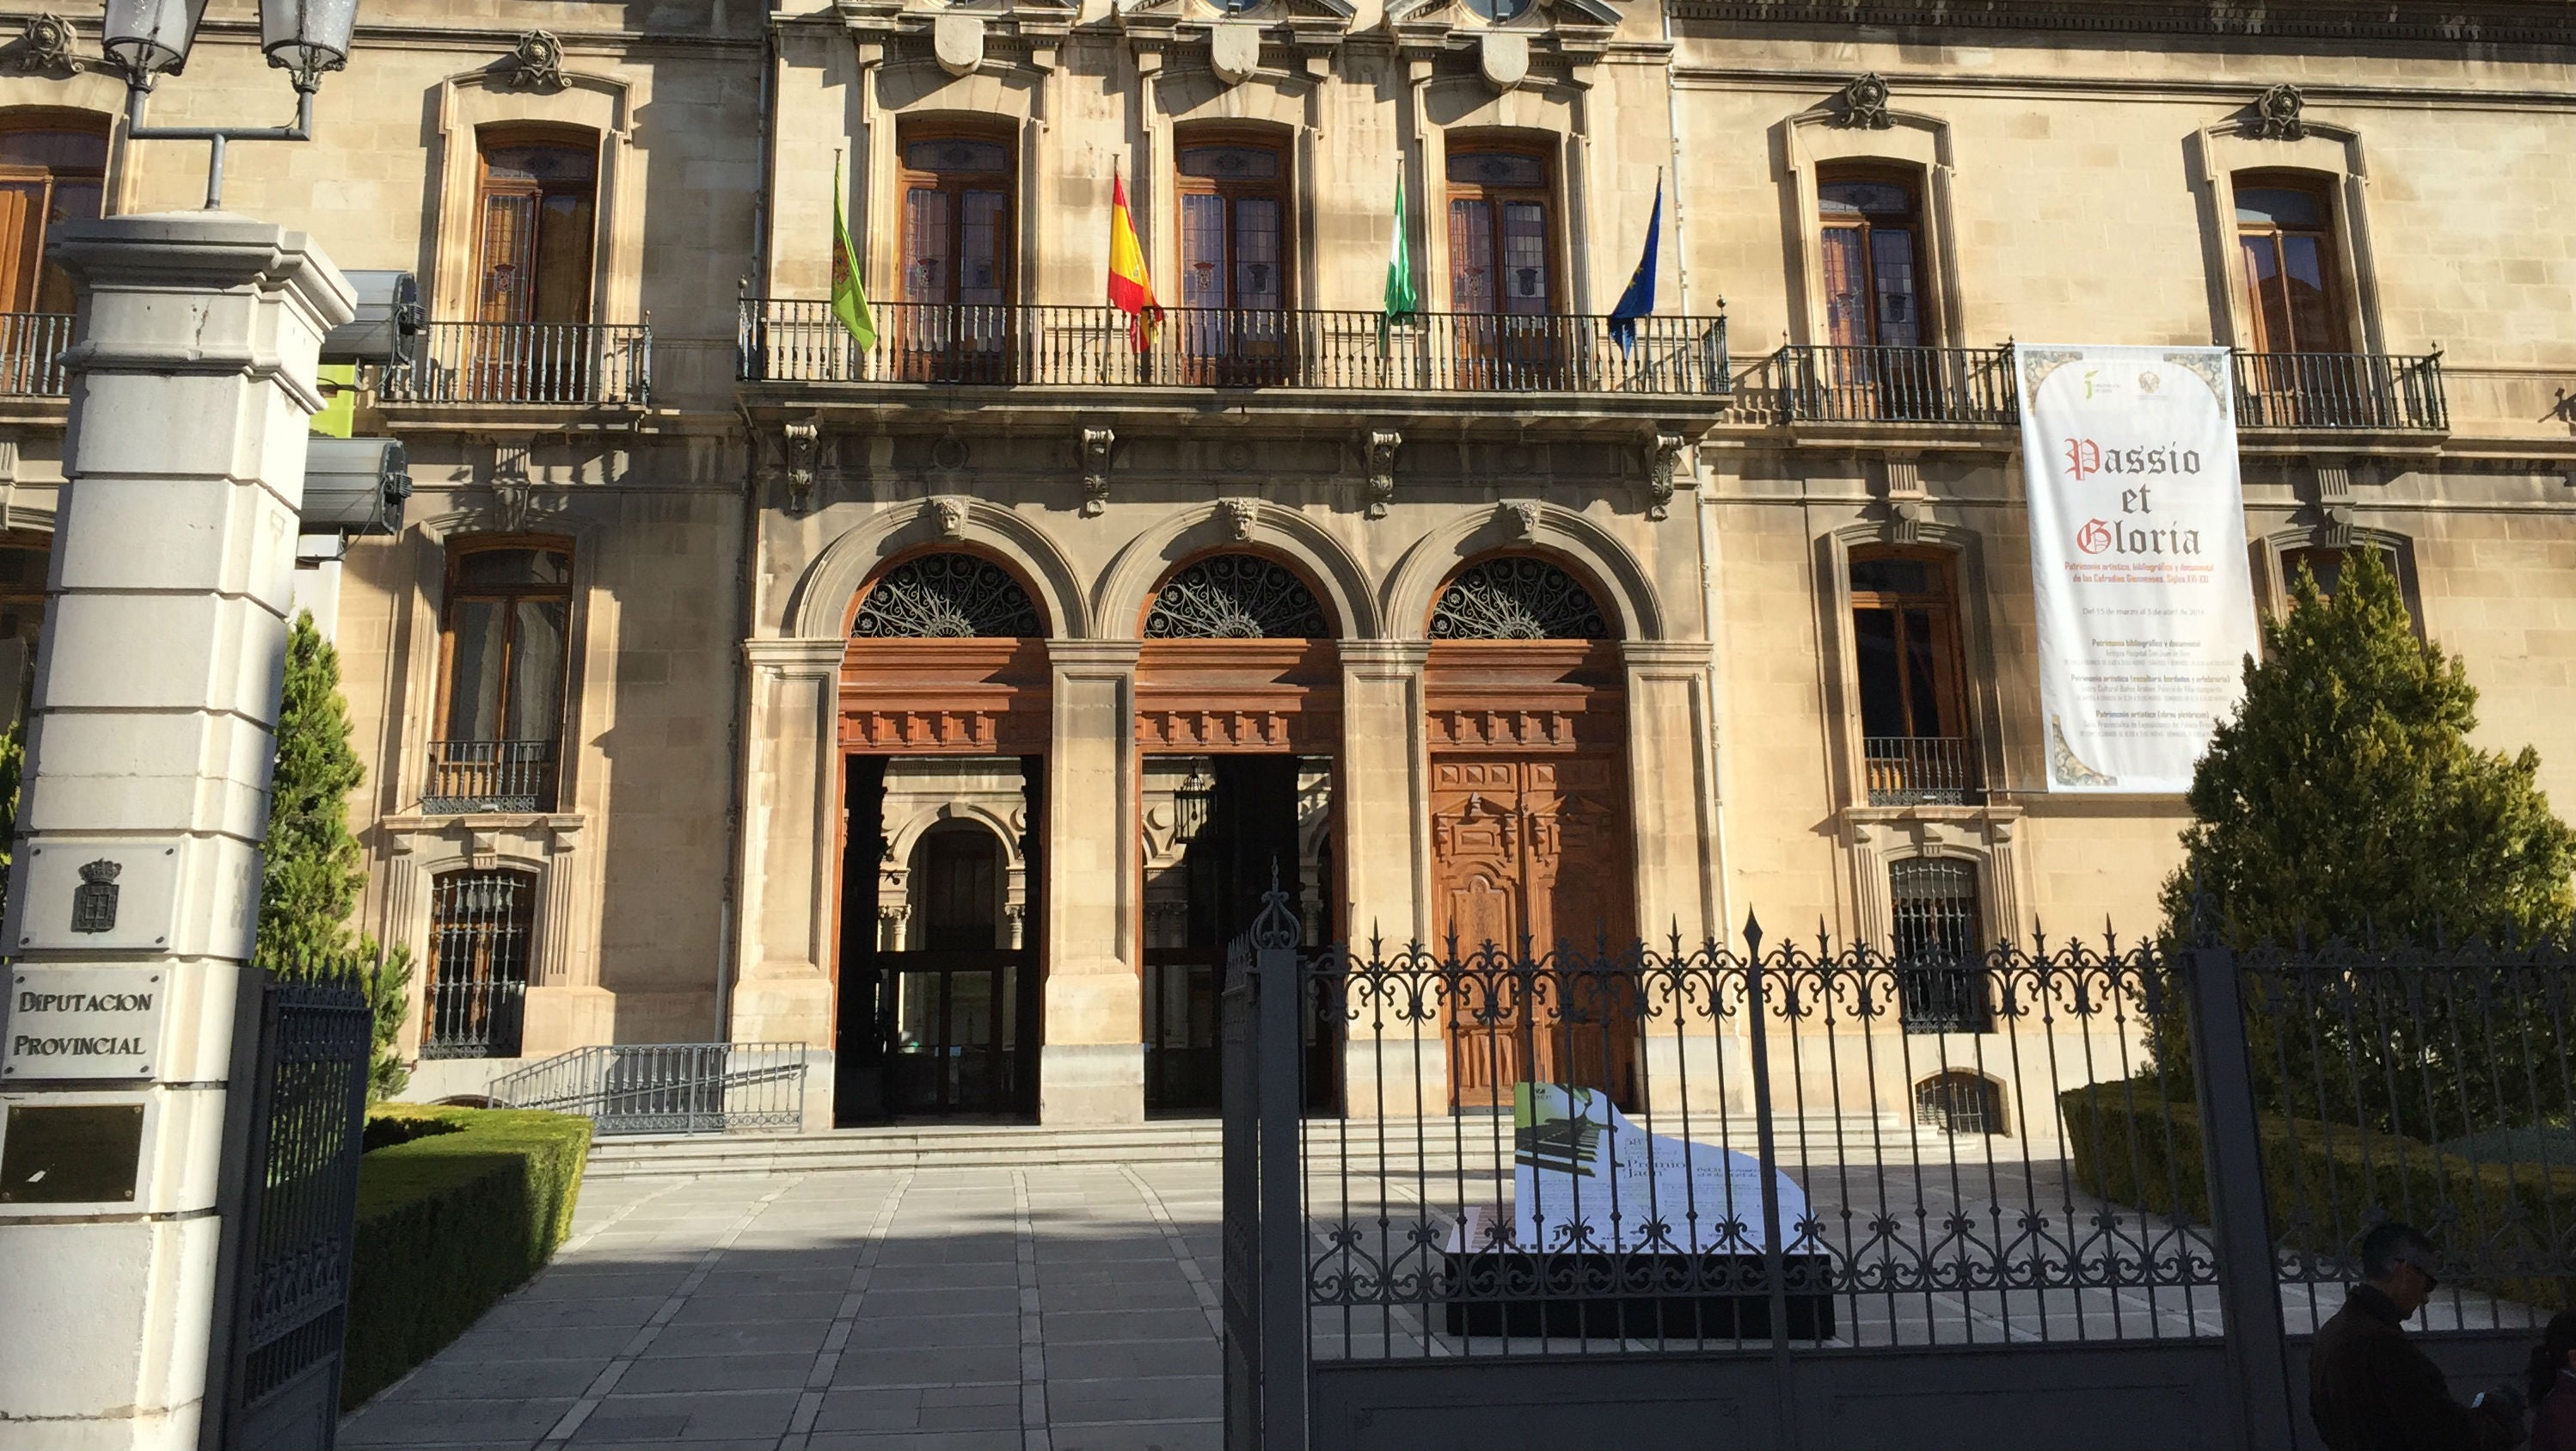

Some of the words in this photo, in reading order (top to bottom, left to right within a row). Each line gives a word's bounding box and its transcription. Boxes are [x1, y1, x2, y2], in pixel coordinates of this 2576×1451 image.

[2064, 438, 2200, 481] Passio
[2122, 483, 2152, 513] et
[2076, 518, 2201, 555] Gloria
[2082, 607, 2095, 616] Del
[18, 992, 153, 1012] DIPUTACION
[14, 1035, 146, 1056] PROVINCIAL
